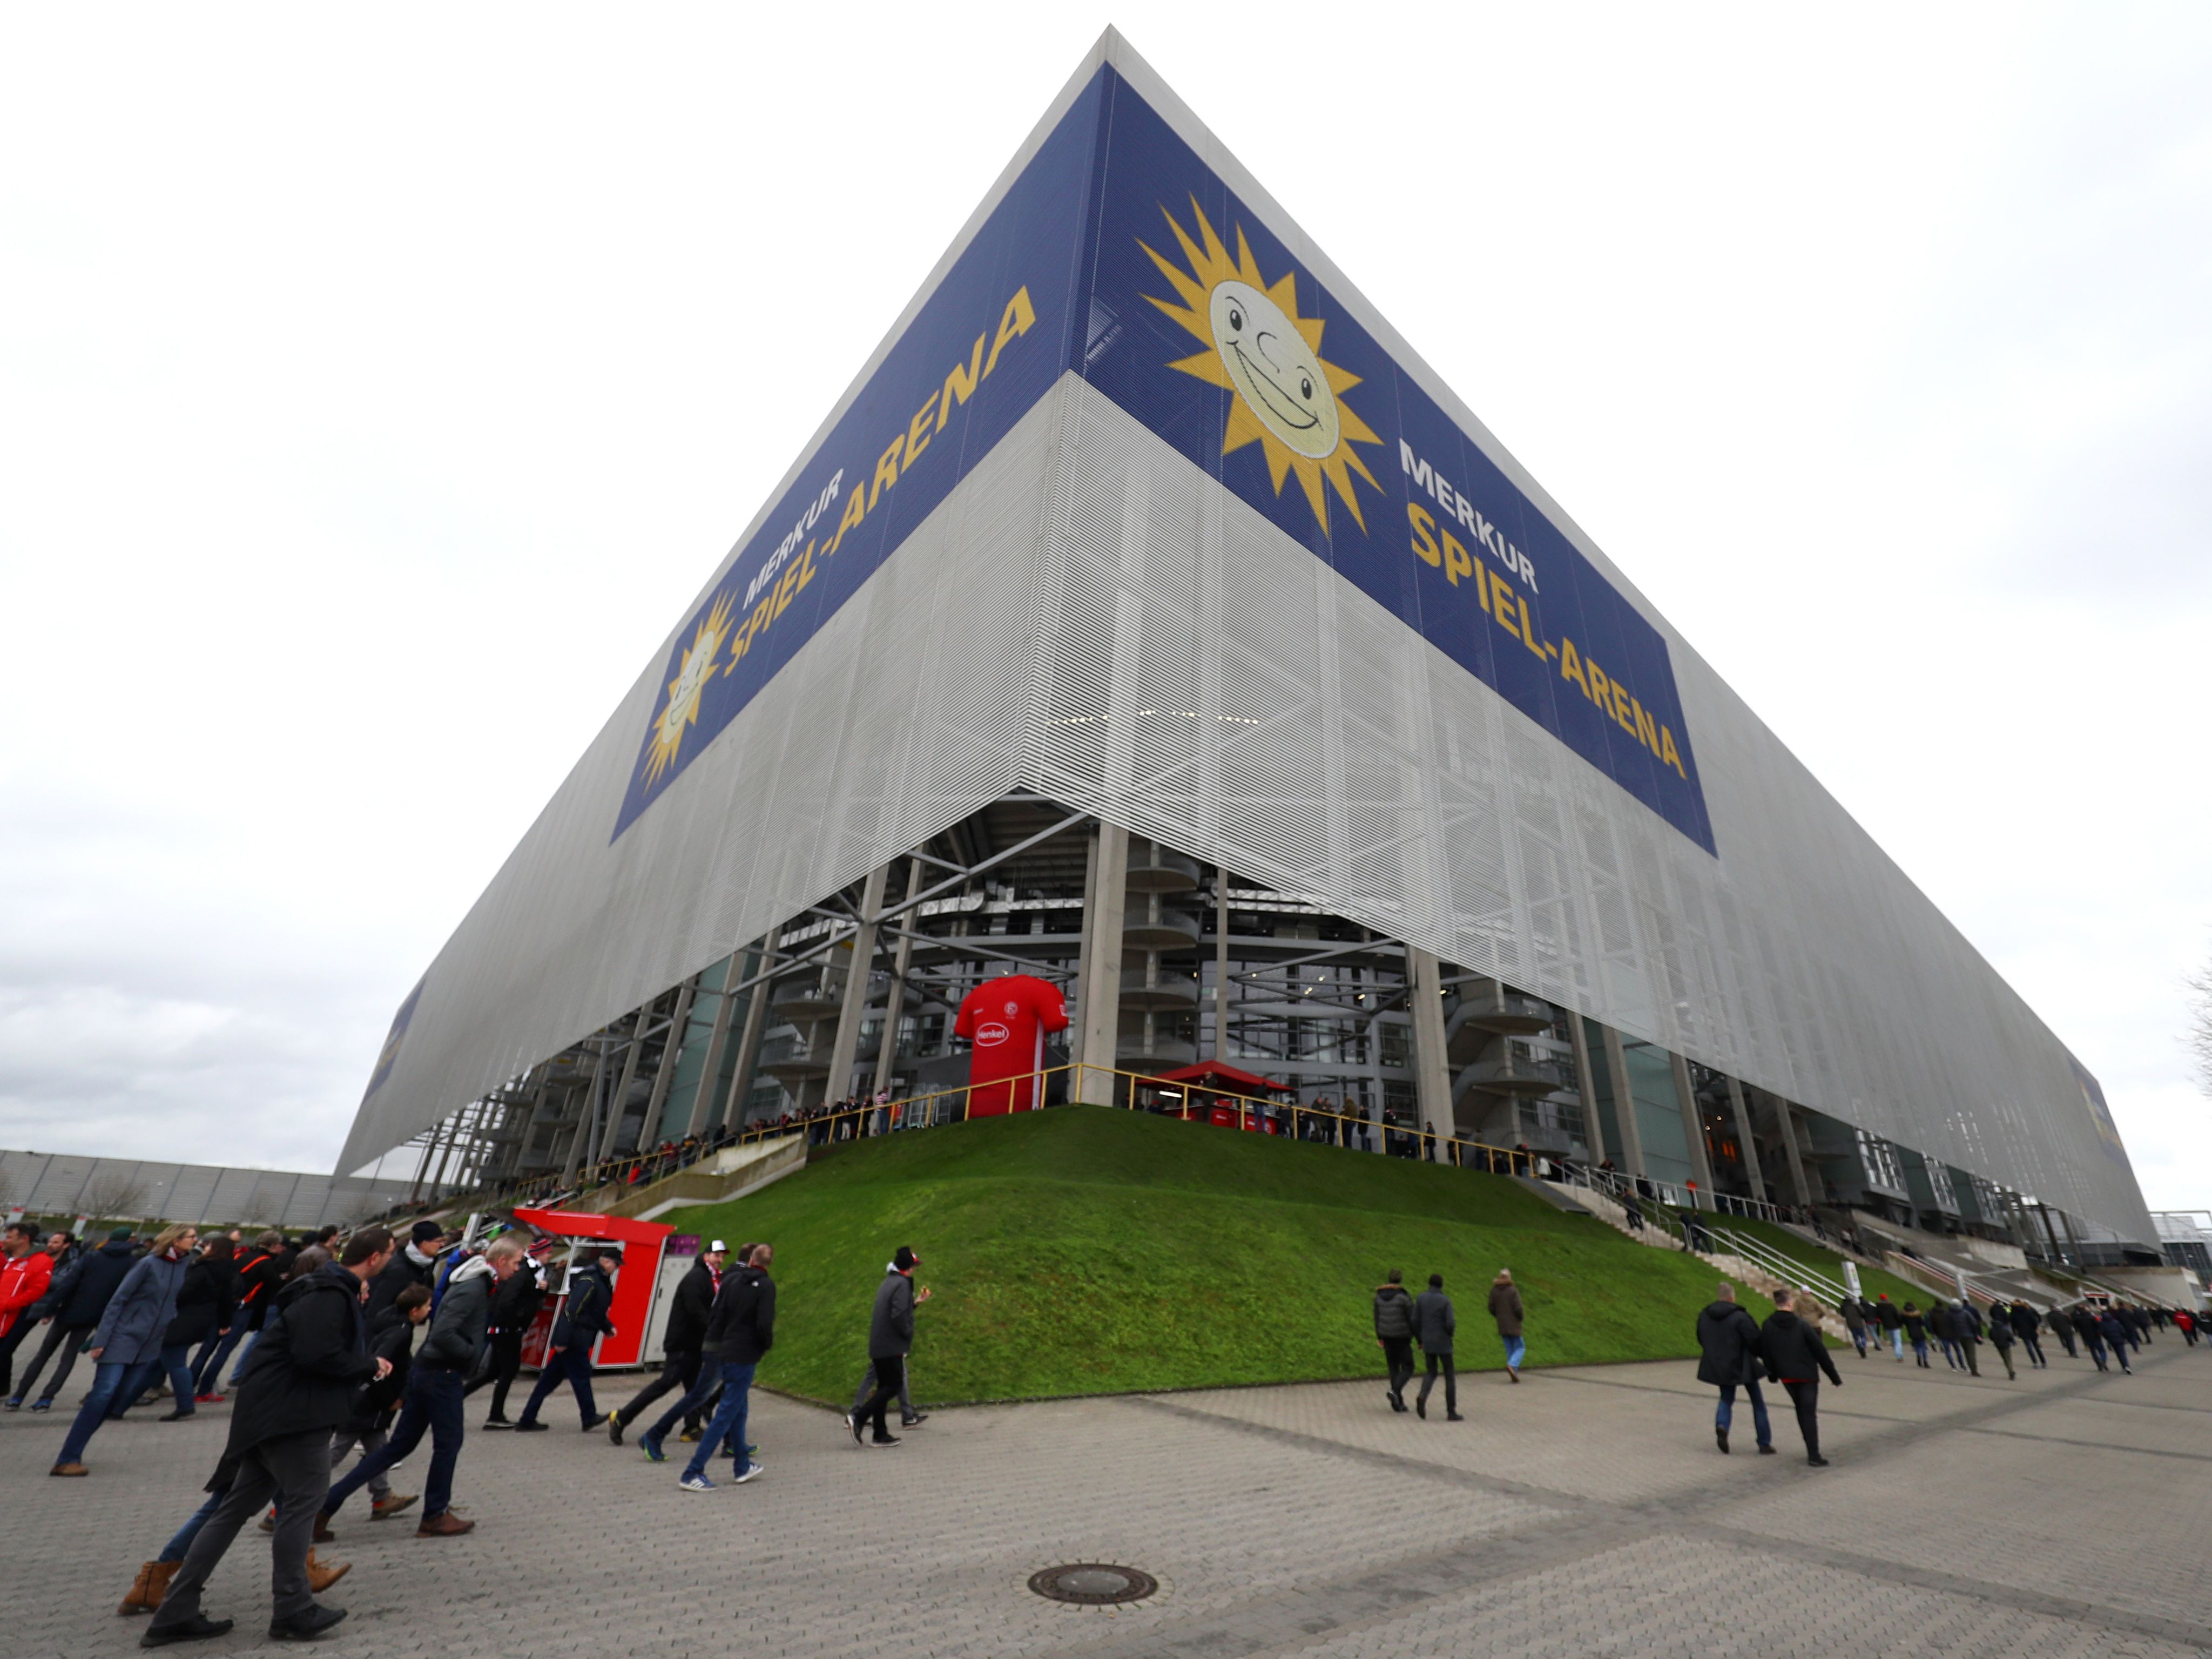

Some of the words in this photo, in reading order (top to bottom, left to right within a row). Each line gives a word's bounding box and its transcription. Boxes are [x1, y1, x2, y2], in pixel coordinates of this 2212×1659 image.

[723, 285, 1036, 677] SPIEL-ARENA
[743, 468, 844, 610] MERKUR
[1399, 437, 1539, 594] MERKUR
[1407, 502, 1687, 779] SPIEL-ARENA
[977, 1029, 1006, 1039] Henkel
